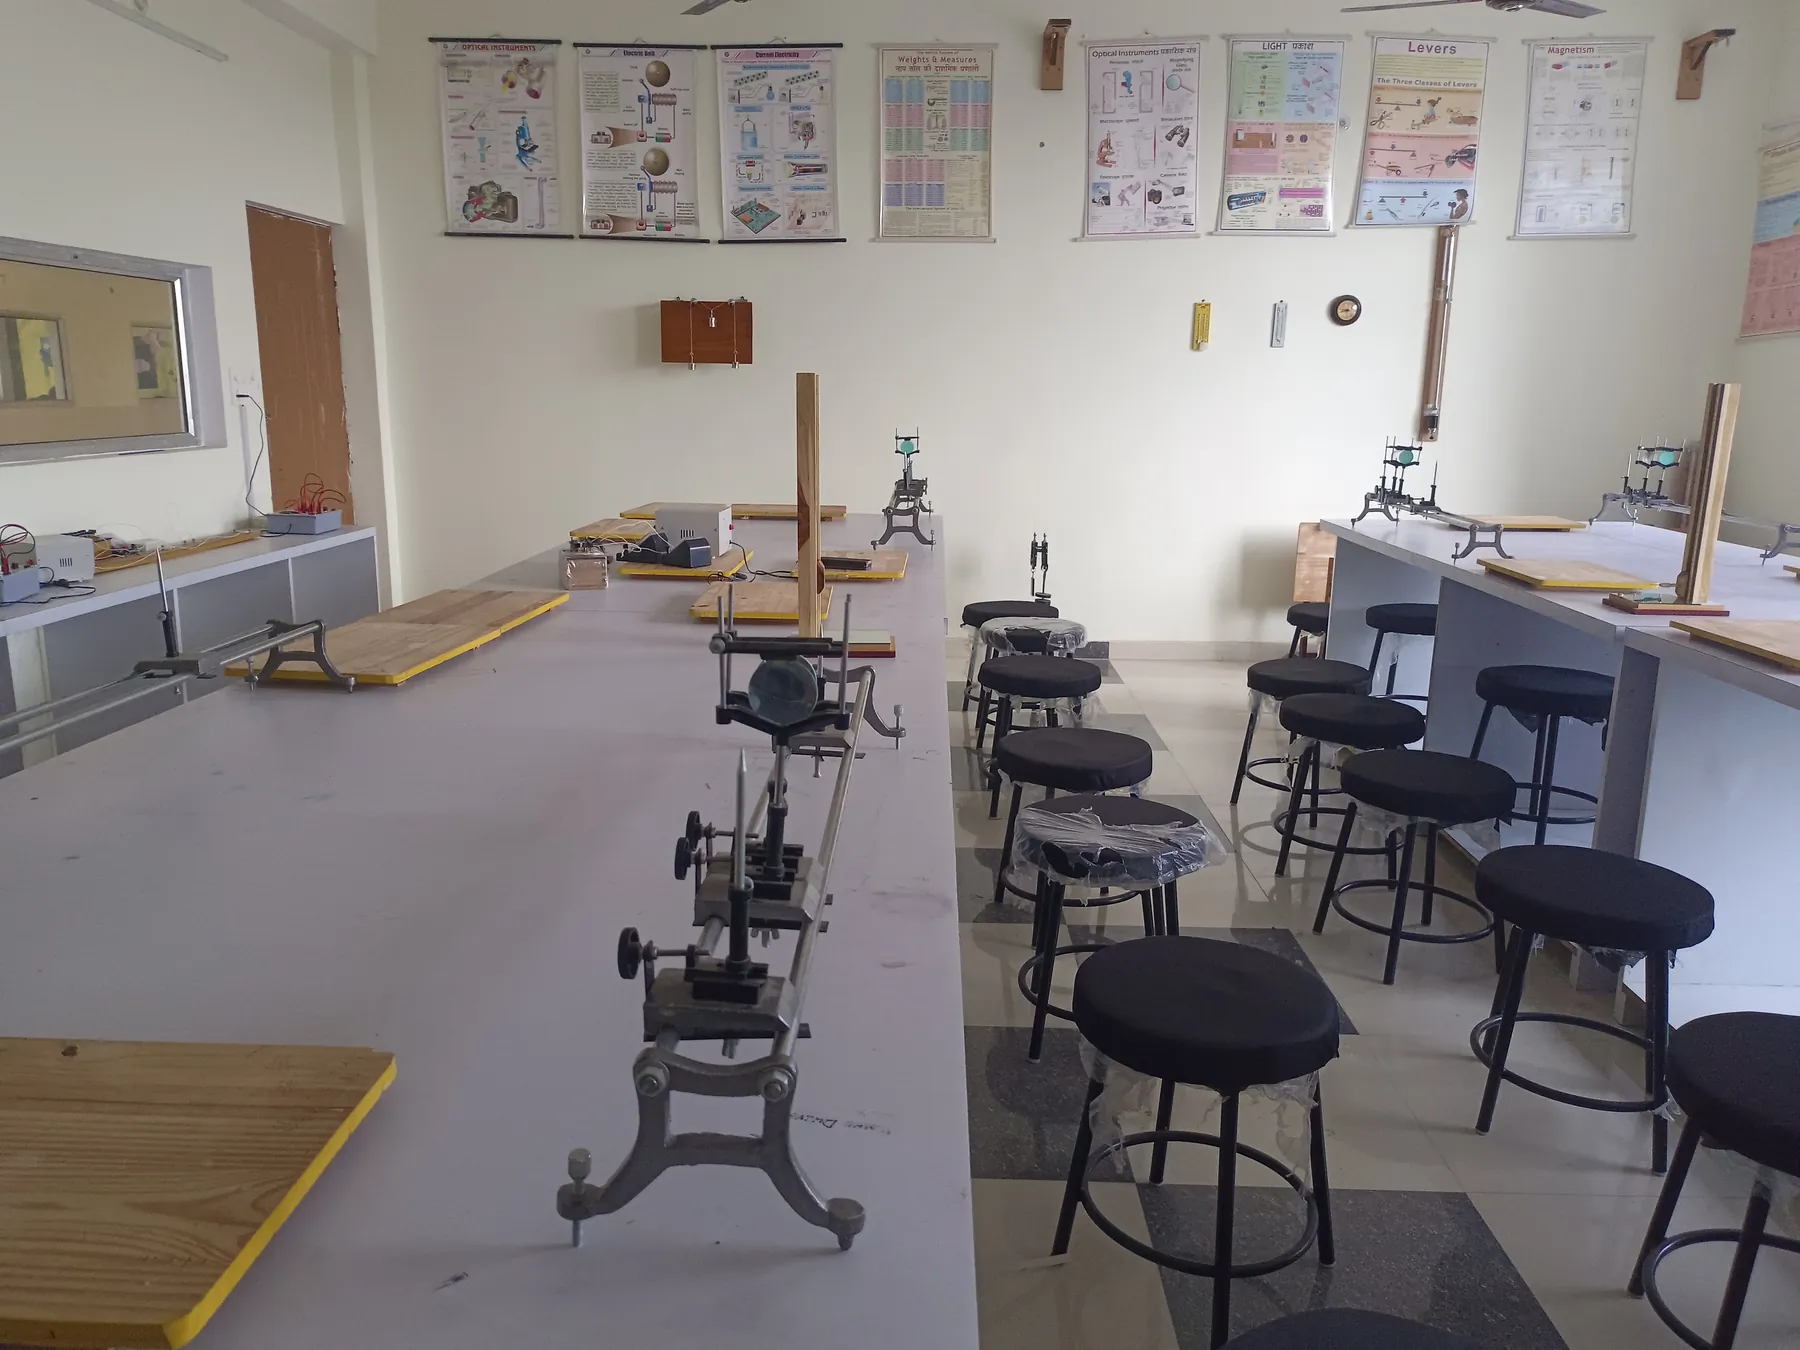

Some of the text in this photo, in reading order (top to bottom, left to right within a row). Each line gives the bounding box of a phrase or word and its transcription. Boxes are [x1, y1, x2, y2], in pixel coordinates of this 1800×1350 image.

[491, 44, 536, 52] INSTRUMENTS
[1263, 42, 1287, 50] LIGHT
[1408, 41, 1457, 54] Levers
[1092, 49, 1159, 58] Optical Instruments
[1547, 46, 1595, 56] Magnetism
[898, 56, 929, 64] Weights
[1414, 79, 1441, 87] Classes
